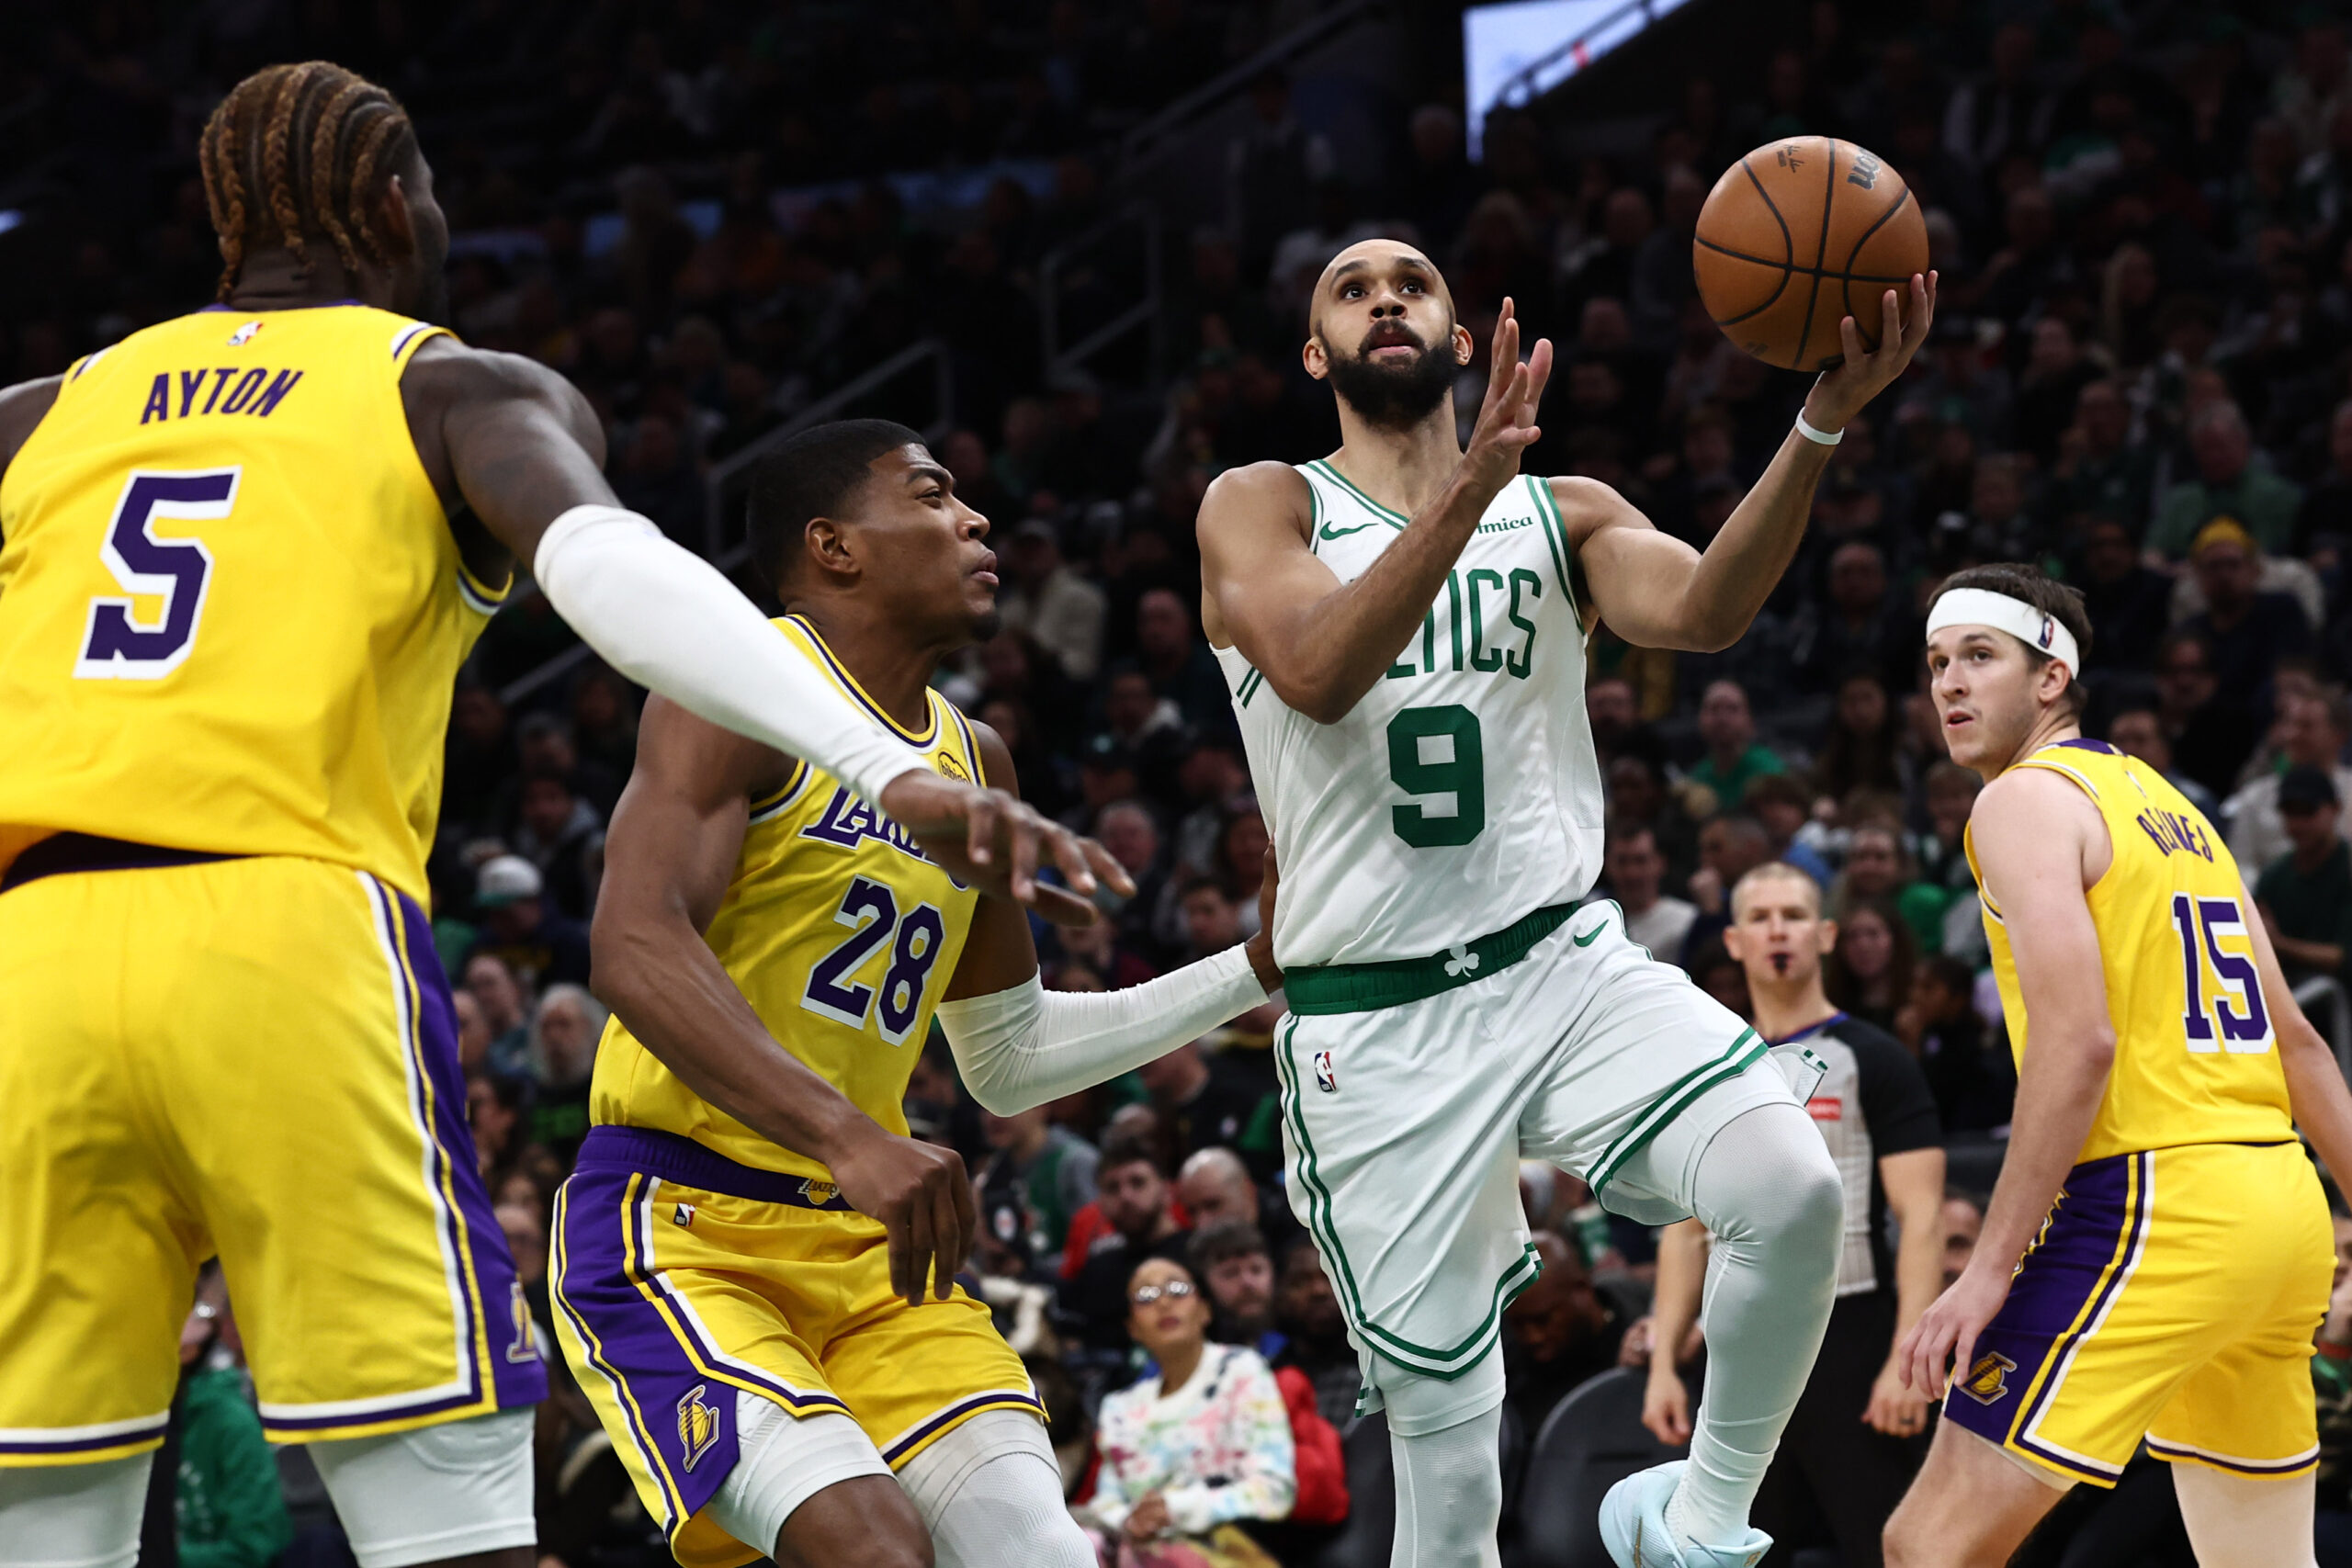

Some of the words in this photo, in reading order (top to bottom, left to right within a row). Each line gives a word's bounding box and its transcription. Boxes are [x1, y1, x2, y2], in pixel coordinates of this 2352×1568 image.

[140, 367, 304, 424] AYTON
[72, 464, 243, 680] 5
[1386, 704, 1486, 848] 9
[799, 874, 946, 1047] 28
[2171, 891, 2276, 1054] 15
